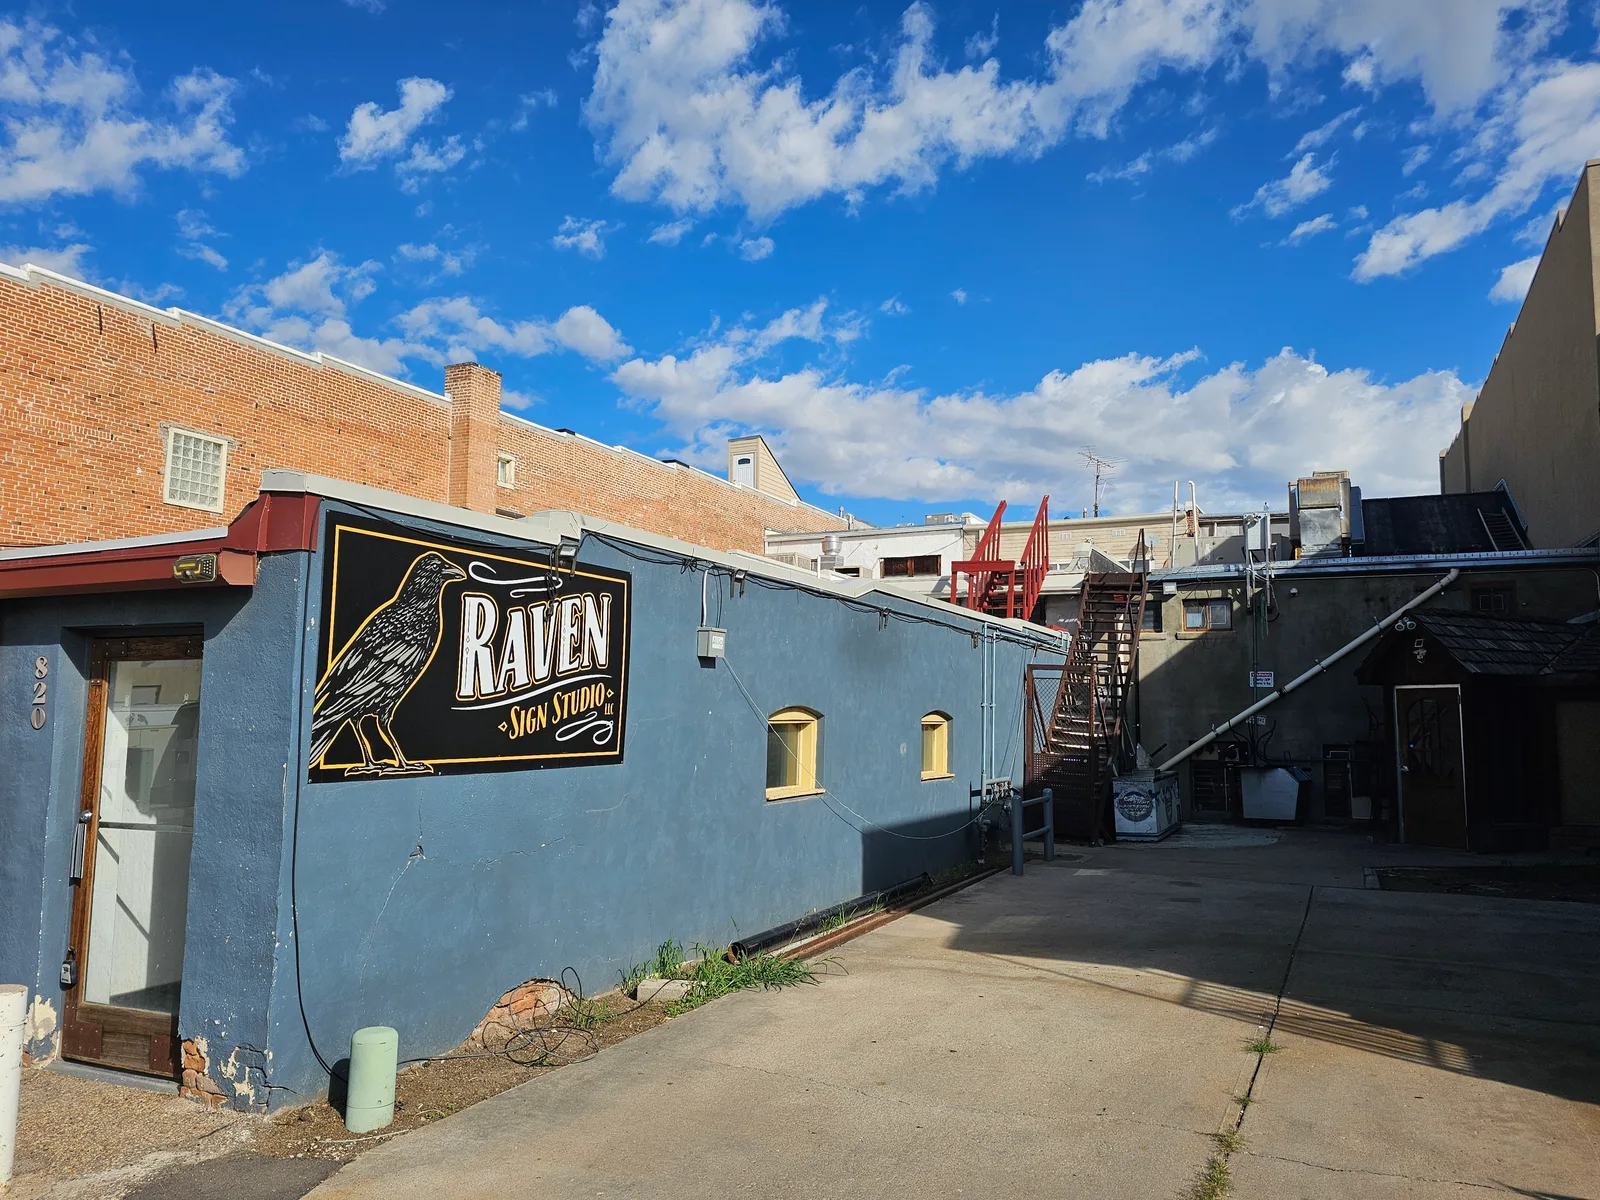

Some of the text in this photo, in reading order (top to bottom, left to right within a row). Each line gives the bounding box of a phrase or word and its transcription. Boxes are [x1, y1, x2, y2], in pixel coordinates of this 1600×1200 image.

[456, 592, 612, 700] RAVEN
[31, 656, 48, 730] 820
[509, 682, 605, 740] SIGN STUDIO
[604, 702, 614, 716] LLC
